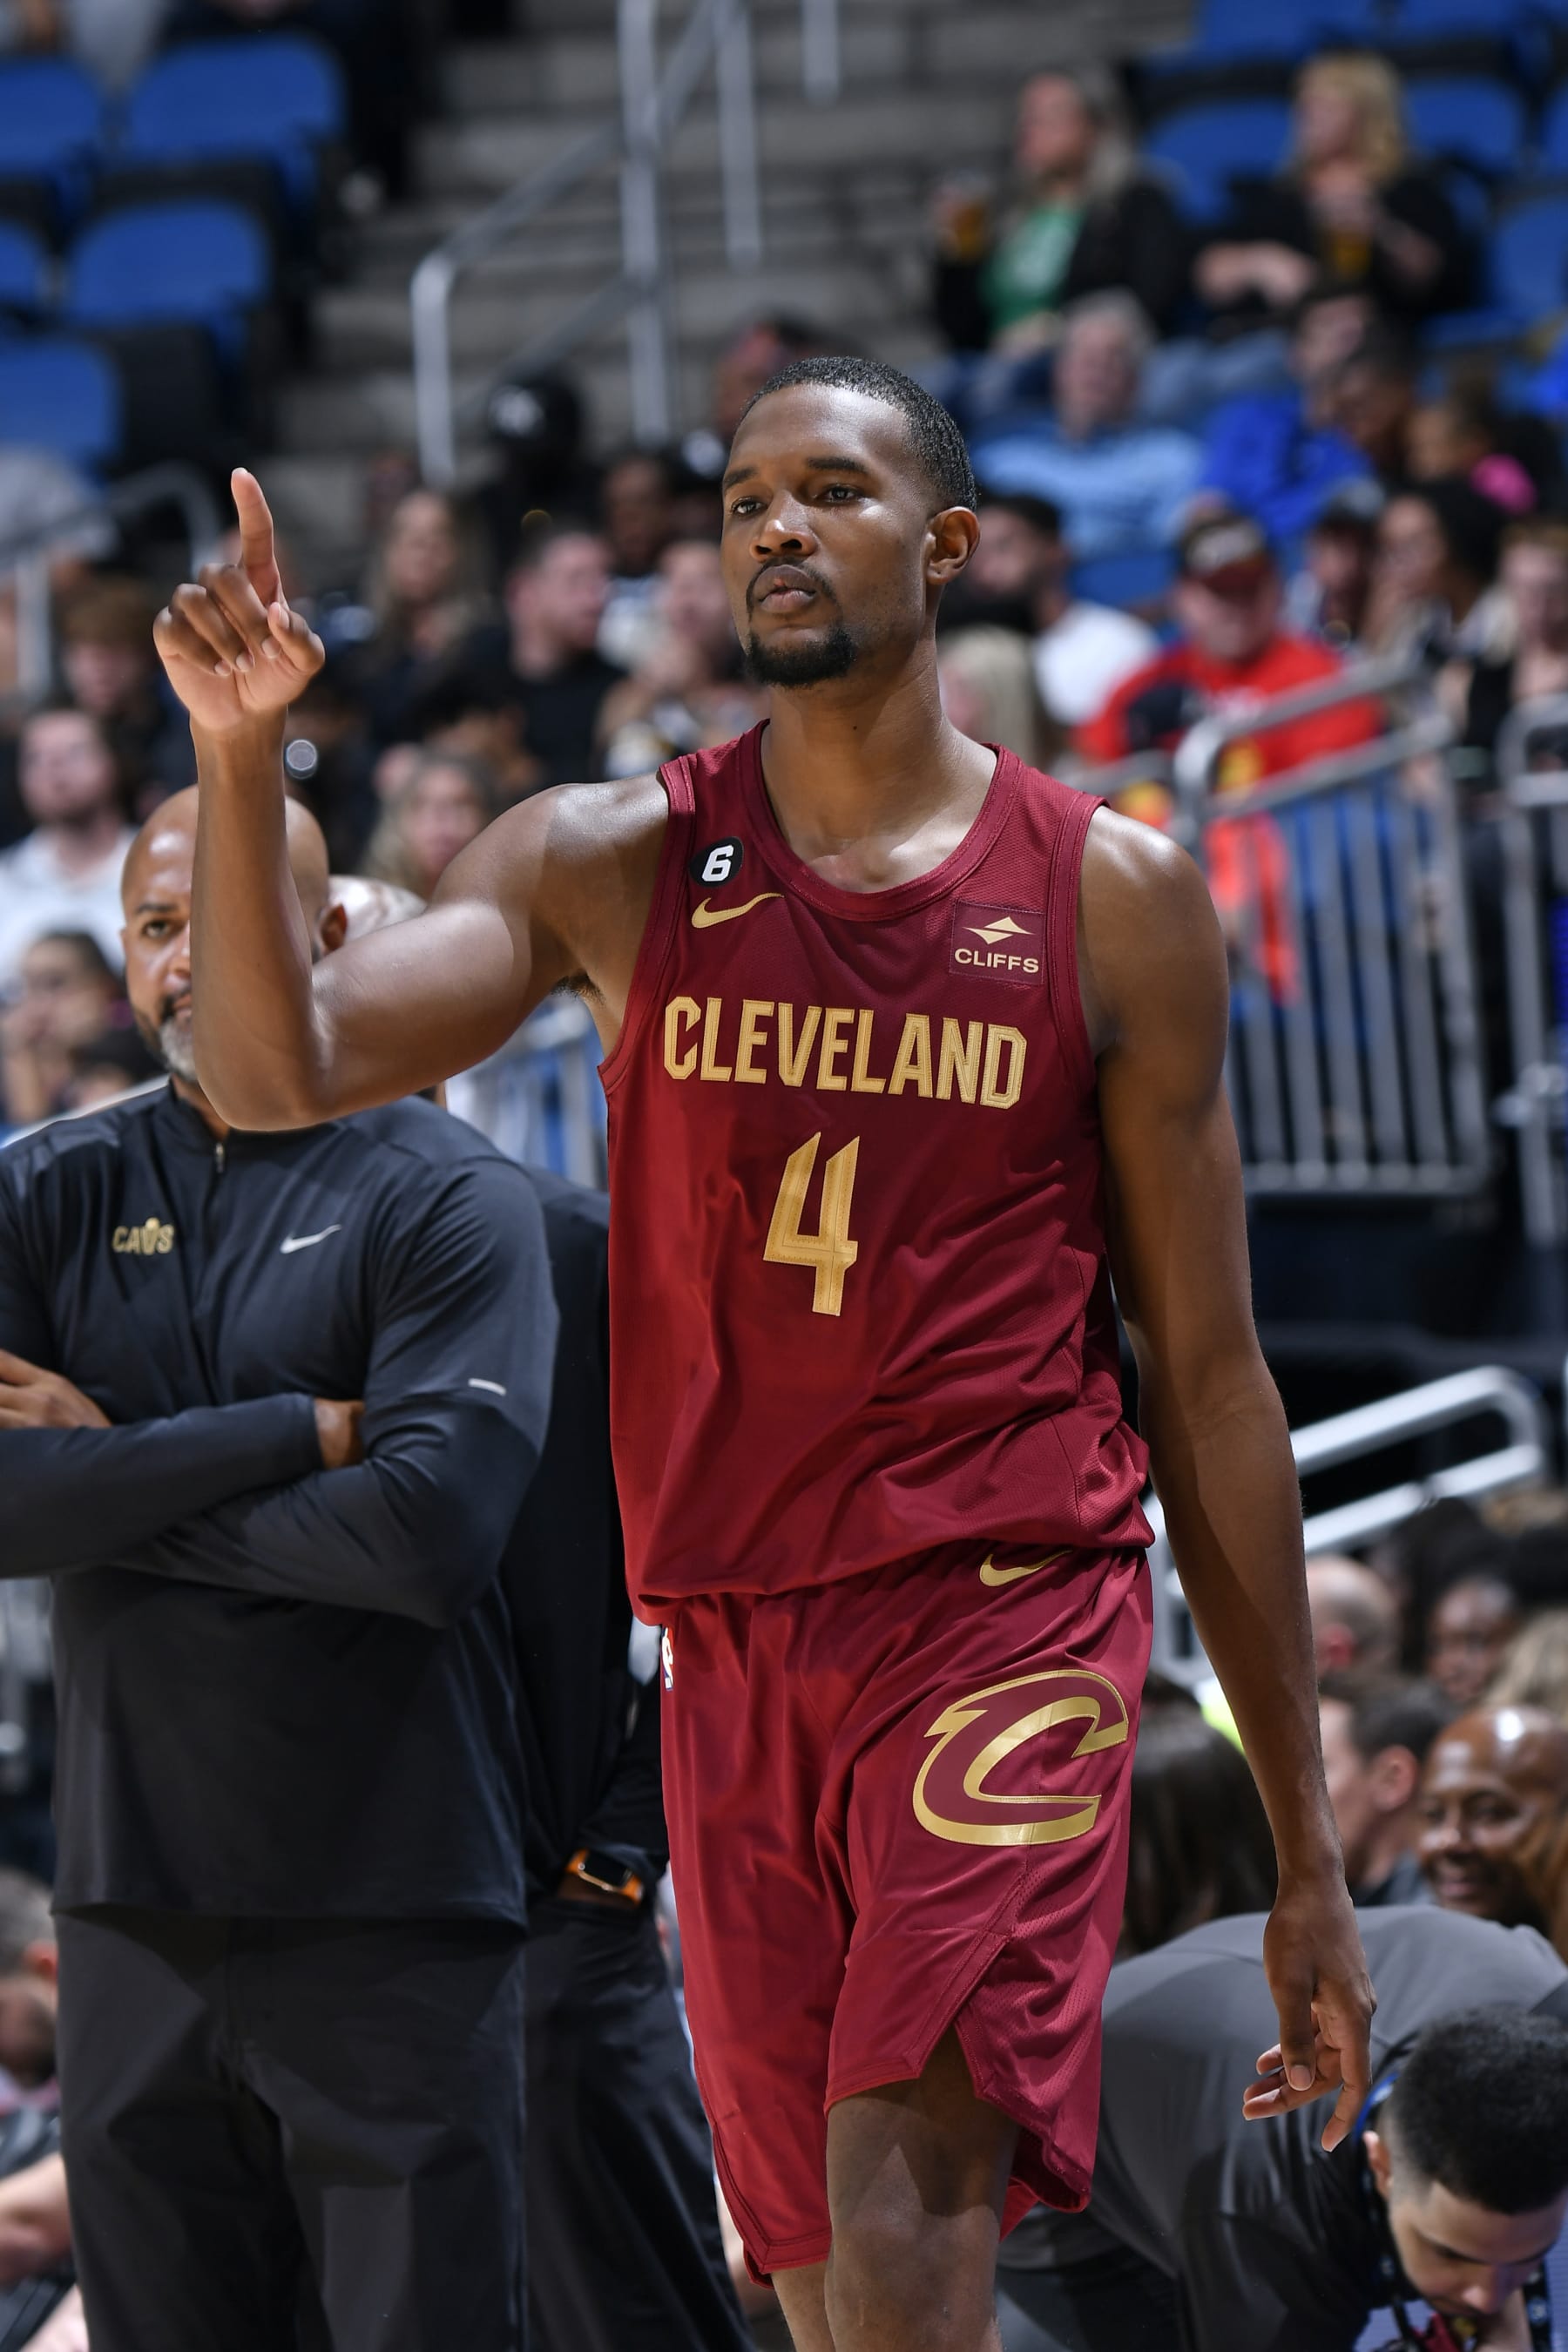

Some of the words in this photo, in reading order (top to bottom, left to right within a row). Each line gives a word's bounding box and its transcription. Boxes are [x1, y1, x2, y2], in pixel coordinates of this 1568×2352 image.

[701, 845, 734, 882] 6
[954, 948, 1039, 974] CLIFFS
[663, 996, 1028, 1110] CLEVELAND
[112, 1217, 174, 1255] CAVS
[762, 1131, 861, 1317] 4
